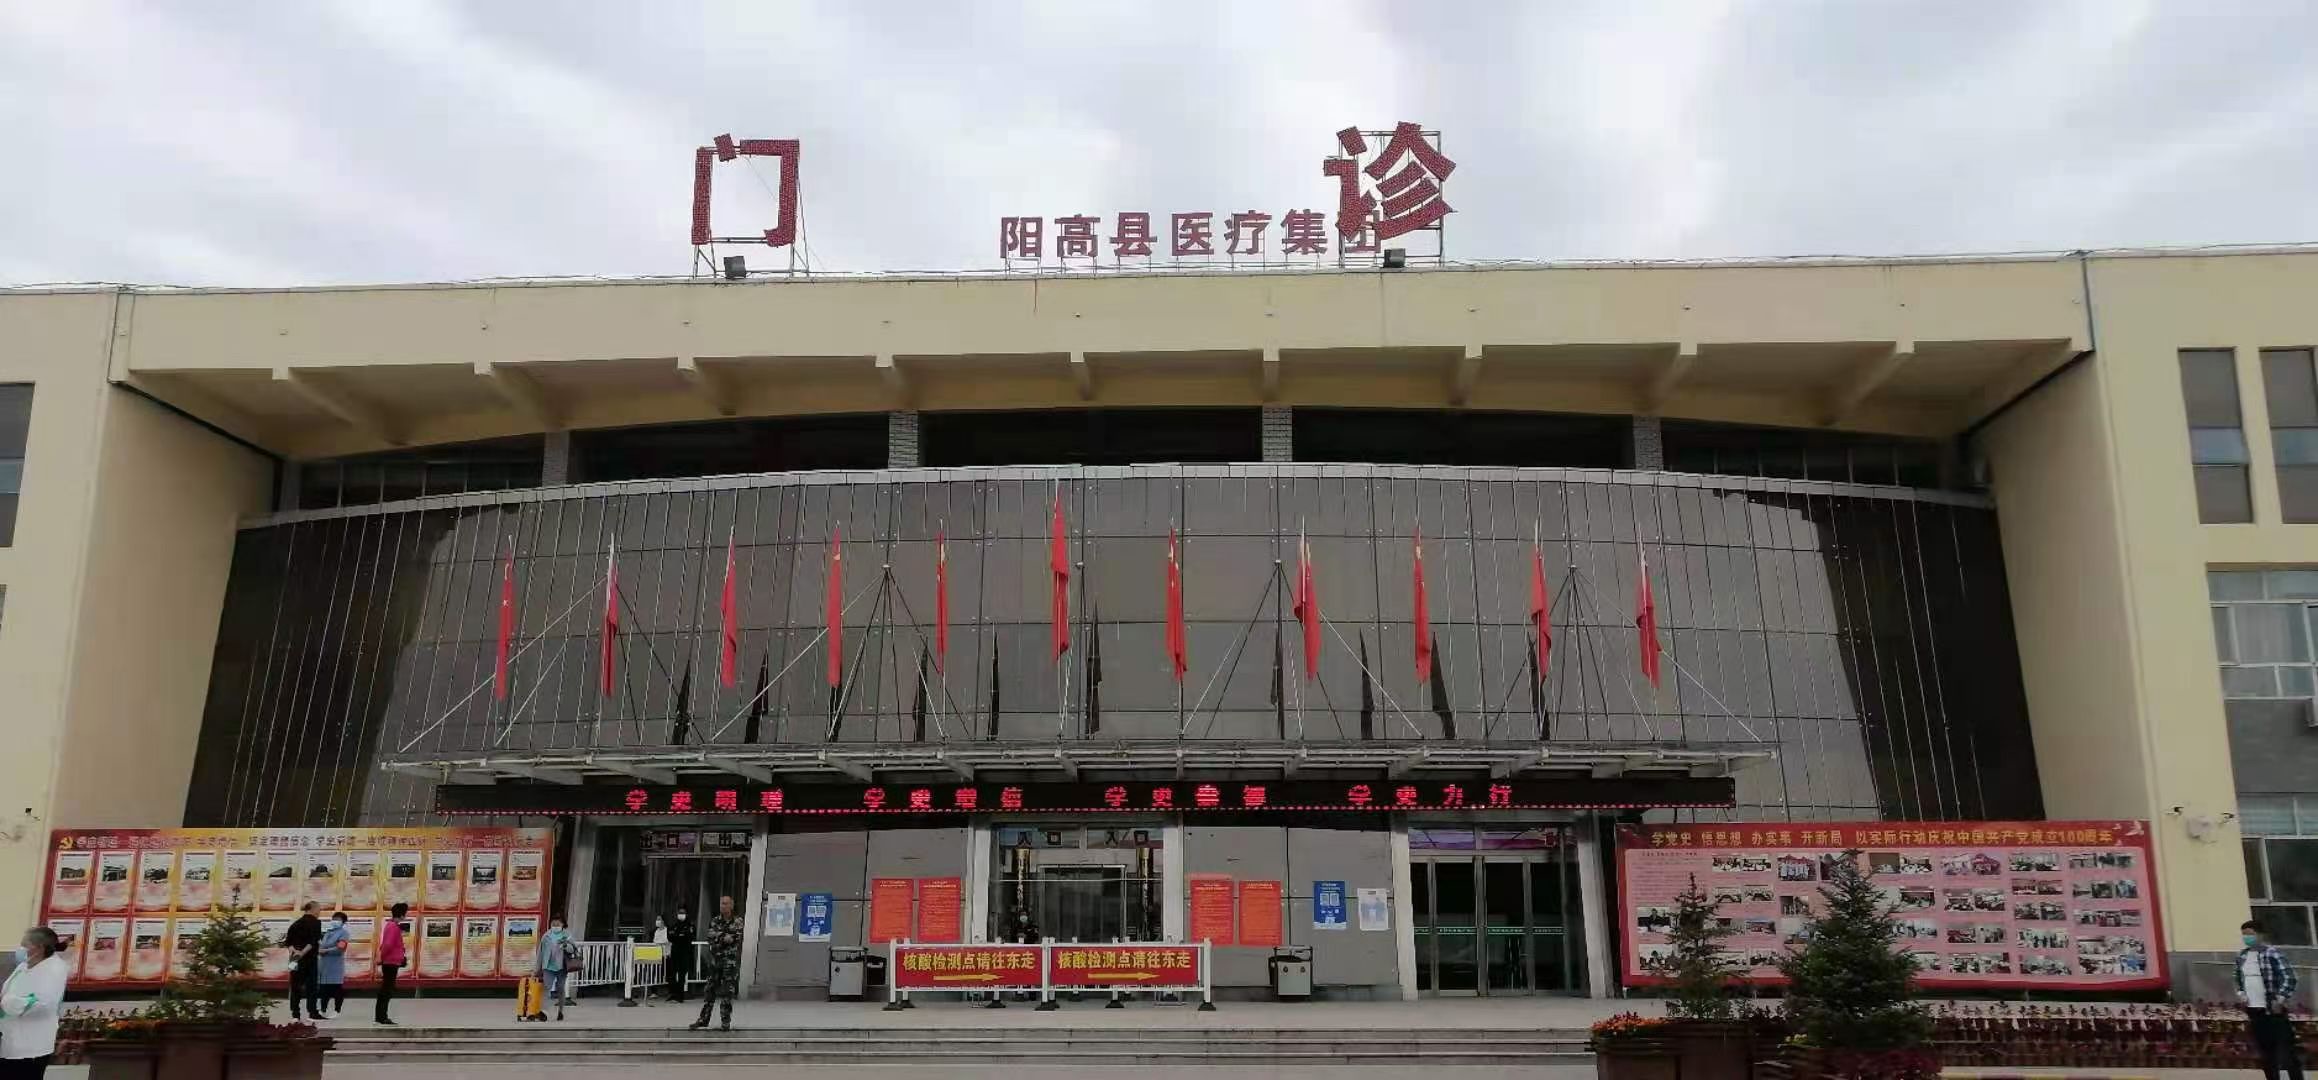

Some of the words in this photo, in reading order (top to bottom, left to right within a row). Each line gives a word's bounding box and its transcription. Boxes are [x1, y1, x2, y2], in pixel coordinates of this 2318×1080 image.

[692, 133, 801, 248] 门
[1323, 121, 1457, 242] 诊
[1651, 831, 1692, 847] 学党史
[1701, 831, 1743, 846] 悟思想
[1751, 830, 1793, 846] 办实事
[1801, 830, 1843, 846] 开新局
[903, 951, 1035, 971] 核酸检测点请往东走
[1057, 950, 1192, 970] 核酸检测点请往东走
